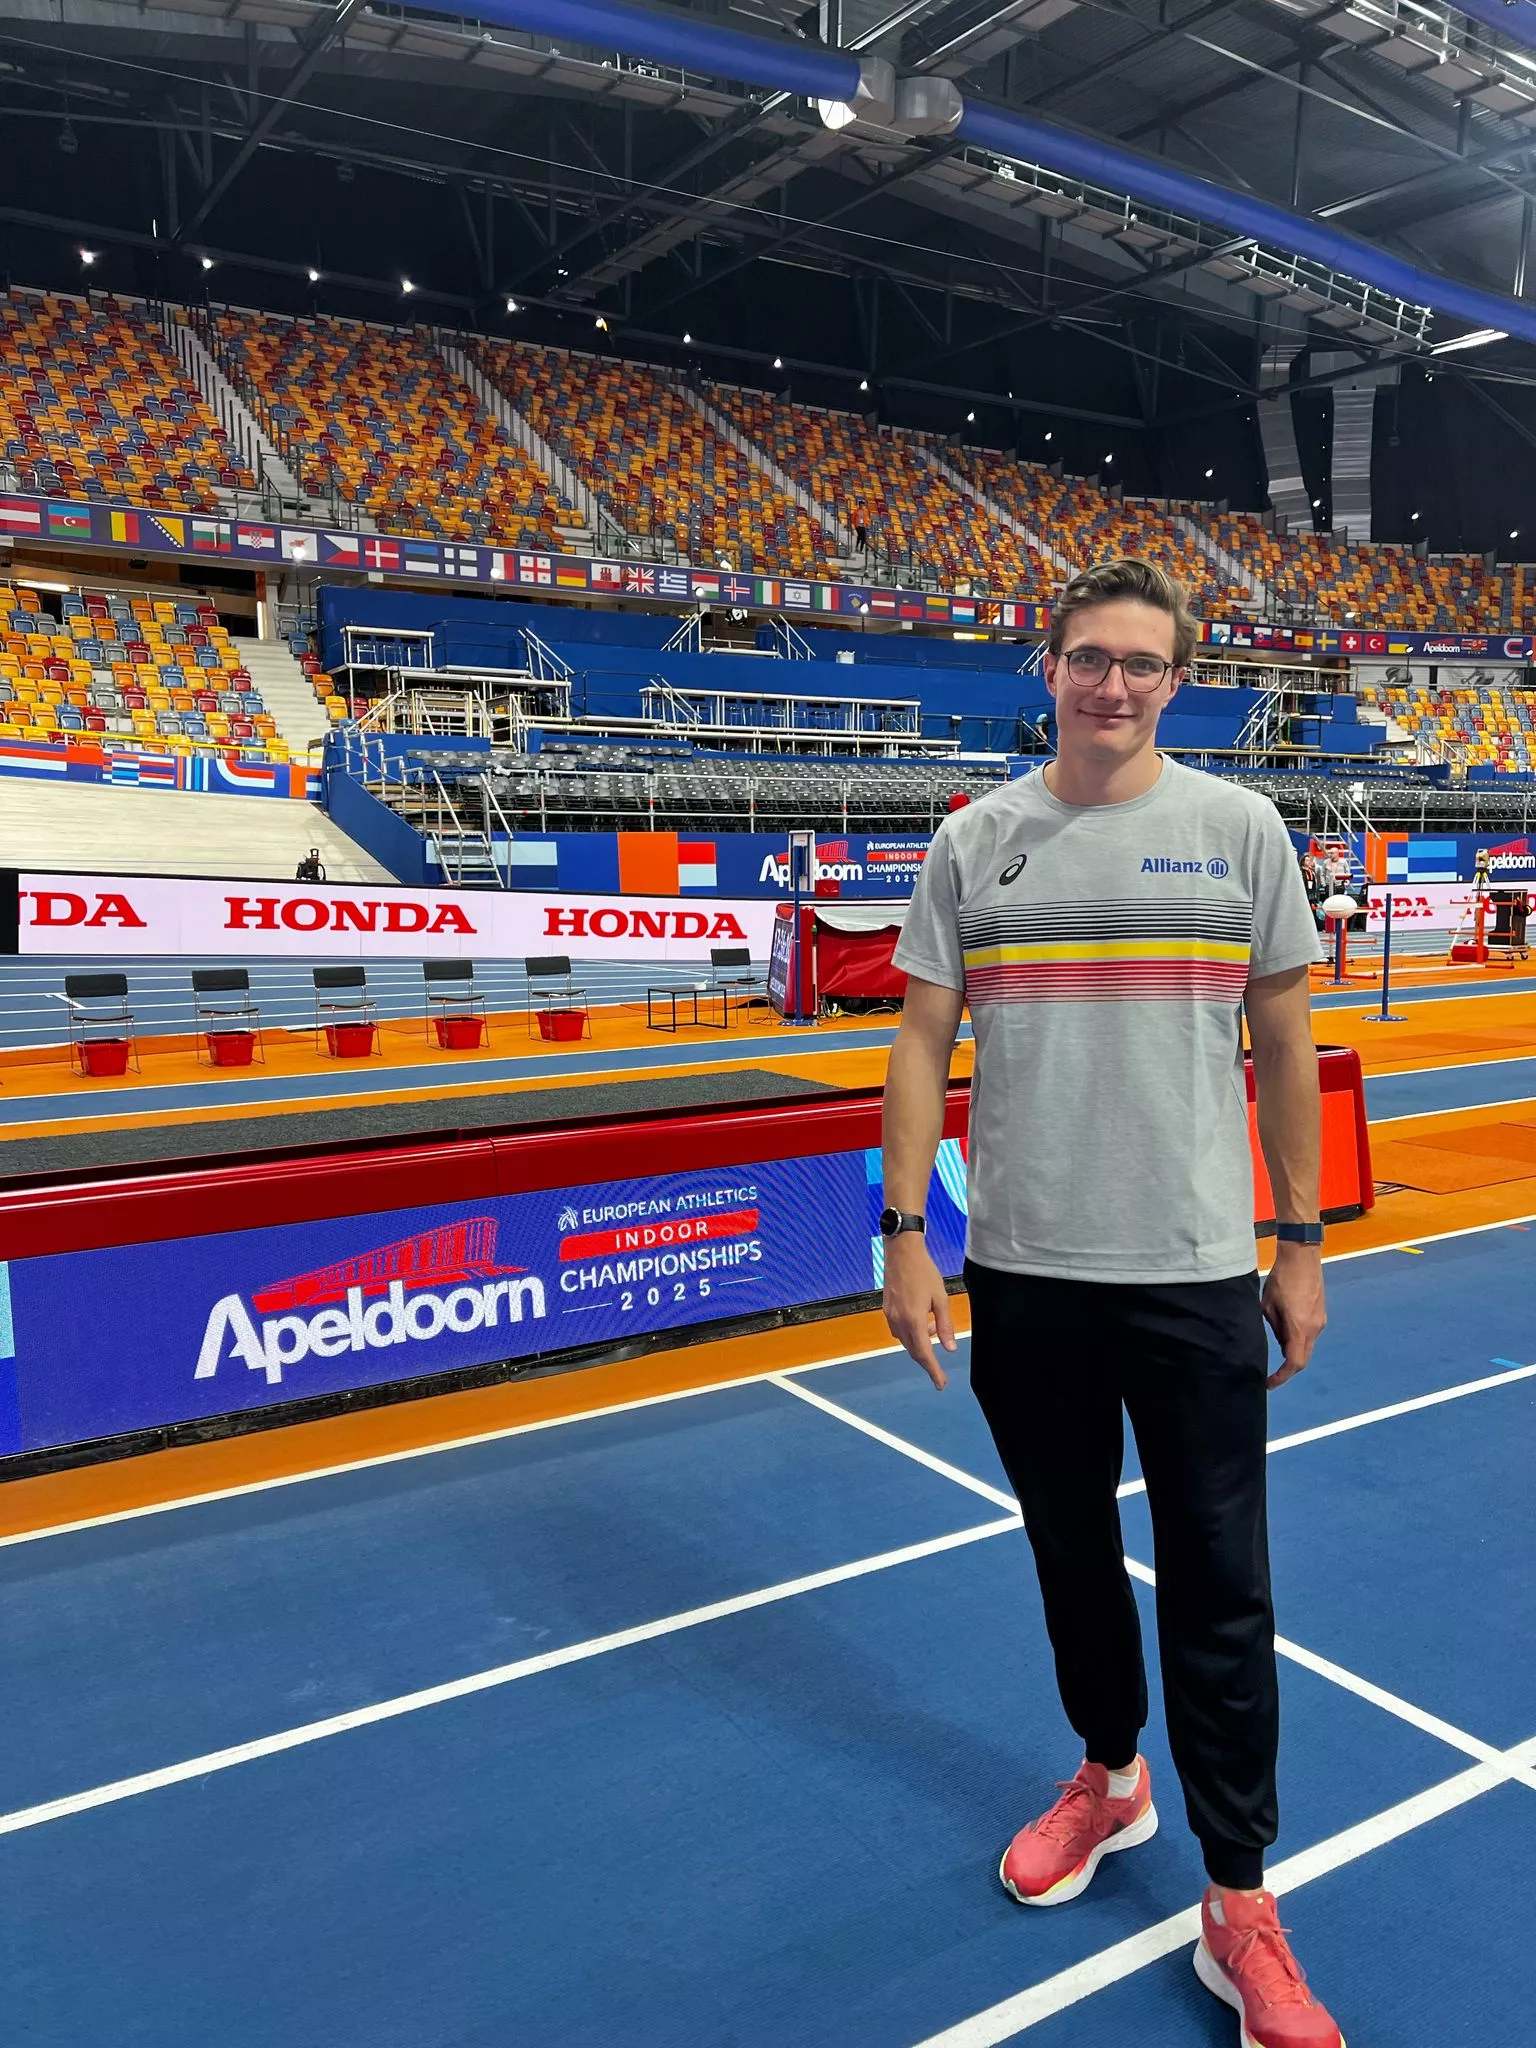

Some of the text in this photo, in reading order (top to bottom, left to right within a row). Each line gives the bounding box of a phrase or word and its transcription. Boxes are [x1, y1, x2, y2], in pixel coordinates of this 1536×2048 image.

[875, 842, 929, 850] EUROPEAN ATHLETI
[885, 852, 918, 860] INDOOR
[1140, 858, 1203, 873] Allianz
[1487, 852, 1535, 874] peldoorn
[886, 874, 918, 883] 2025
[18, 892, 147, 927] DA
[224, 897, 477, 933] HONDA
[1367, 897, 1433, 918] NDA
[543, 908, 747, 939] HONDA
[583, 1186, 758, 1224] EUROPEAN ATHLETICS
[615, 1221, 709, 1249] INDOOR
[560, 1240, 762, 1293] CHAMPIONSHIPS
[620, 1278, 711, 1311] 2025
[194, 1274, 546, 1385] Apeldoorn
